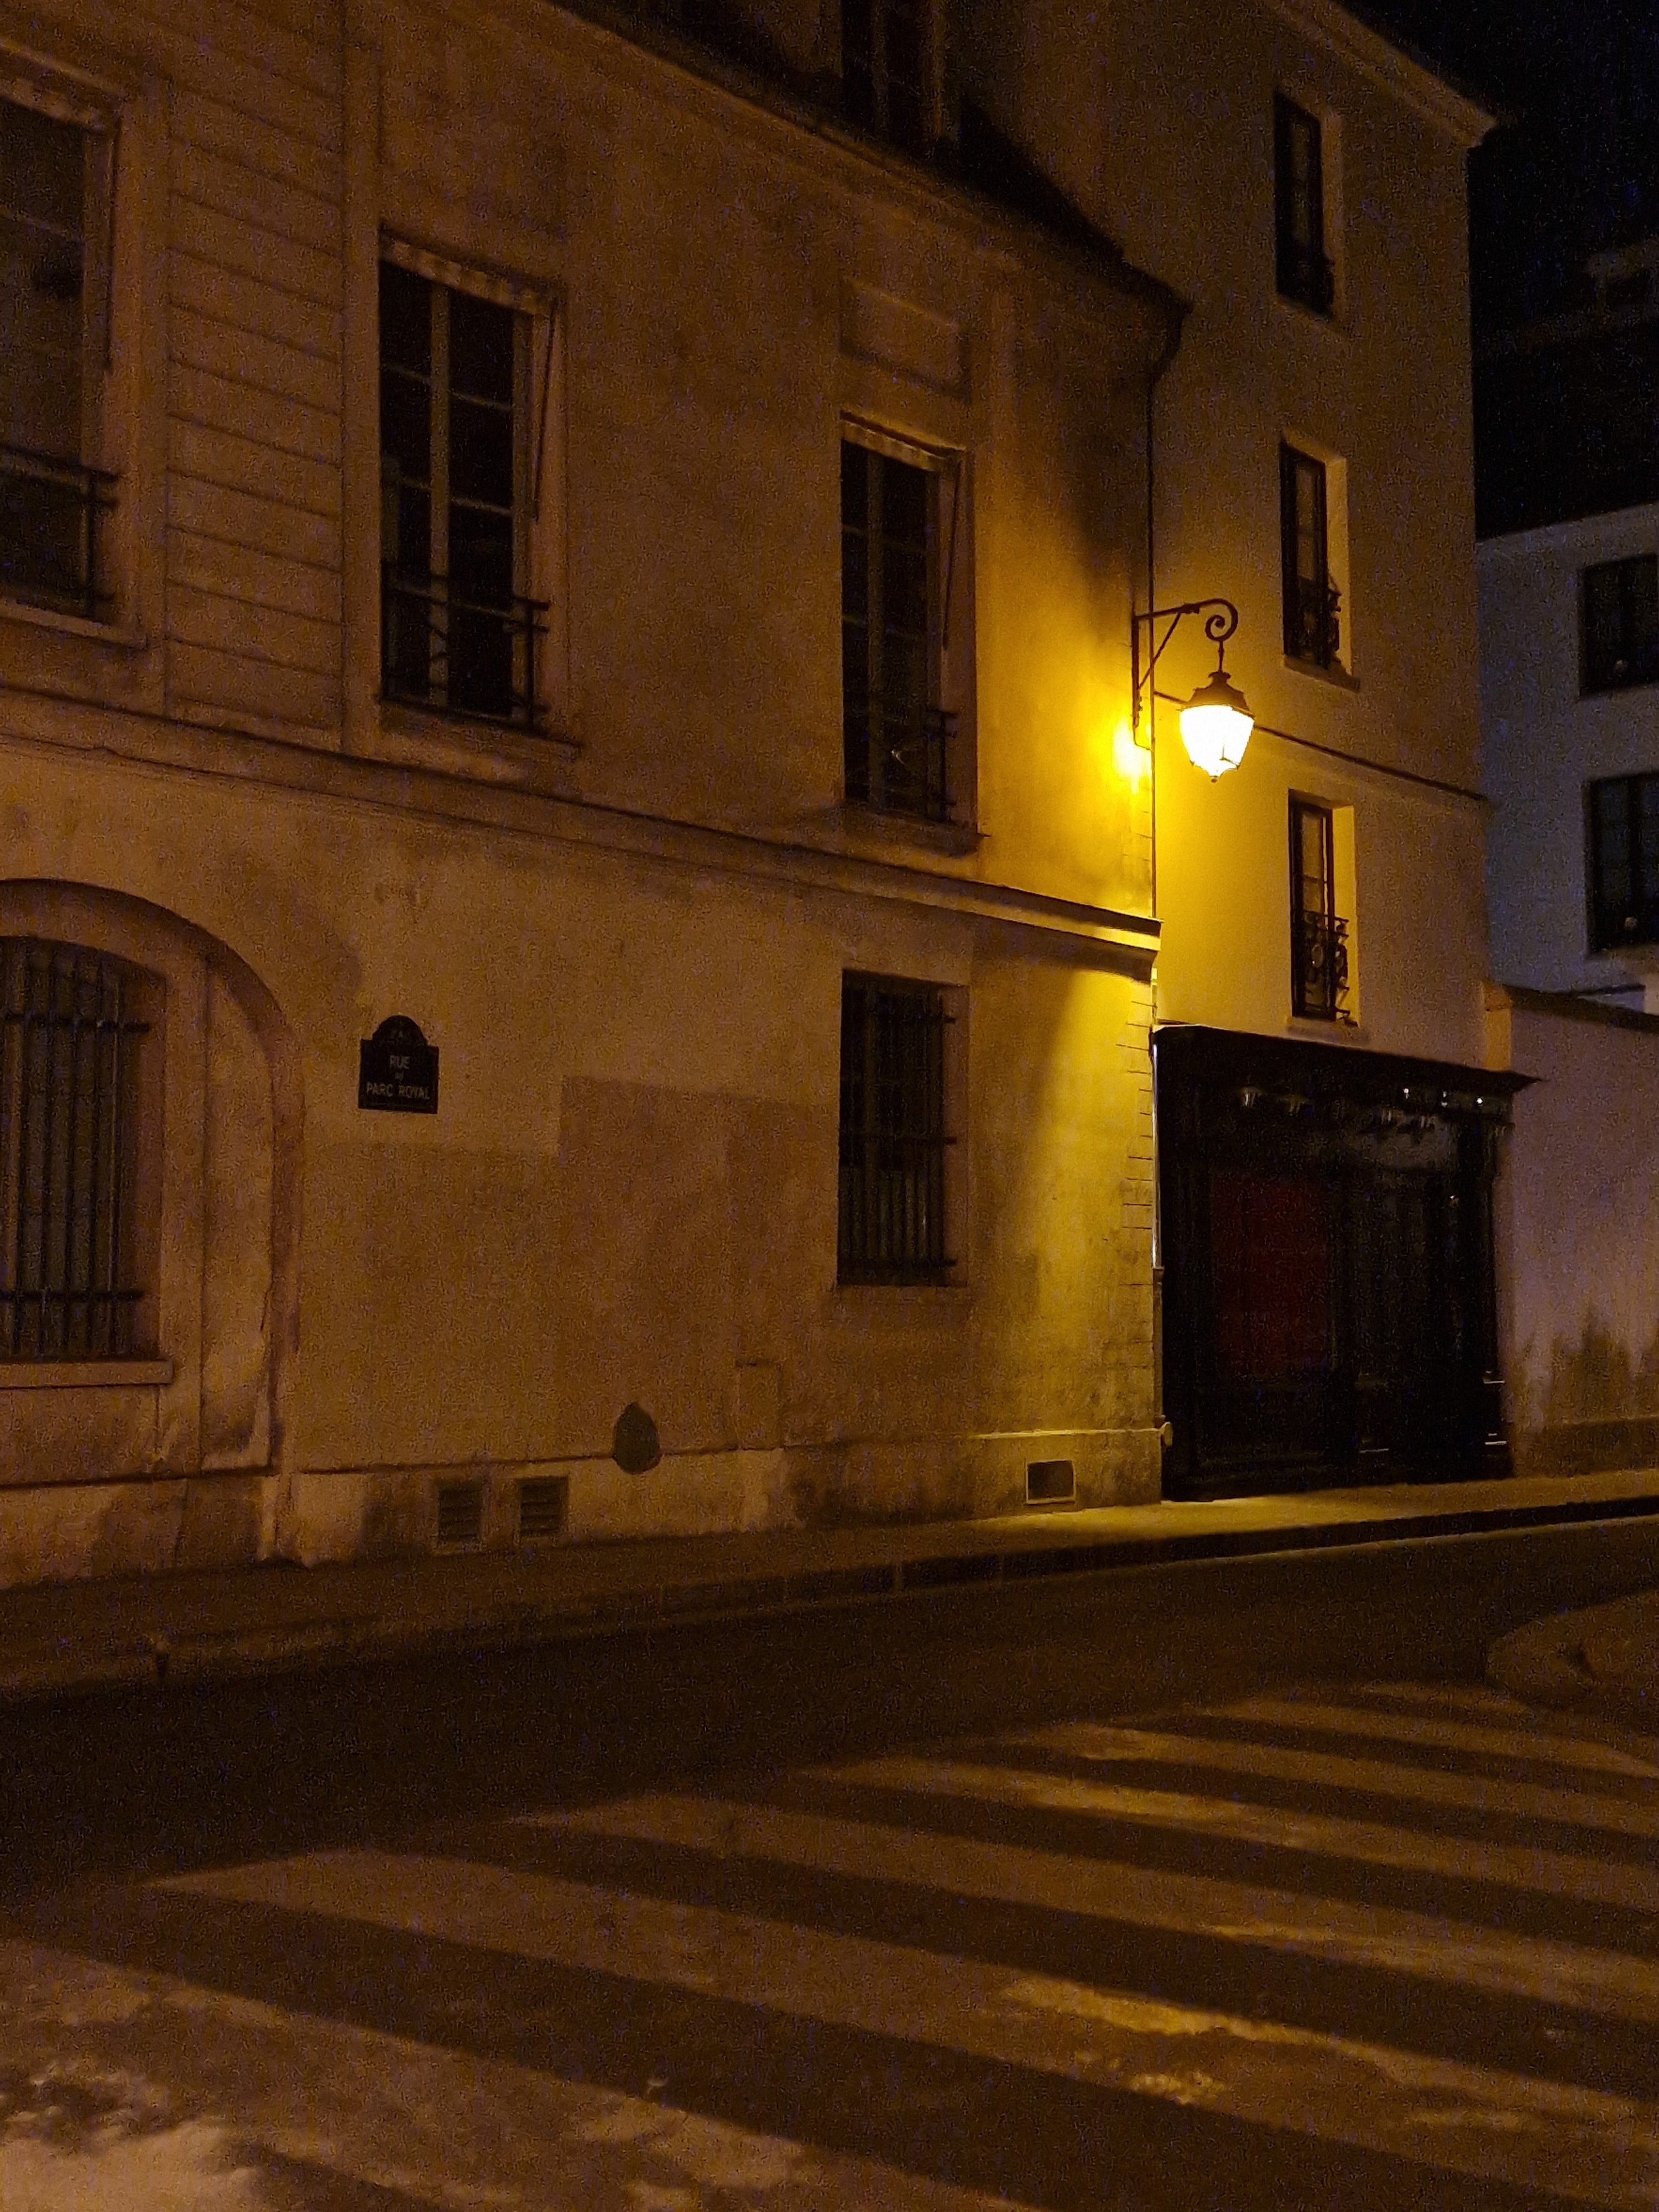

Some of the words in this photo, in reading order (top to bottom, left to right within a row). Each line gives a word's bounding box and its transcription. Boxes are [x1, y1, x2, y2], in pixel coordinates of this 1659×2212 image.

[389, 1055, 410, 1070] RUE
[366, 1082, 394, 1097] PARC
[398, 1084, 430, 1100] ROYAL
